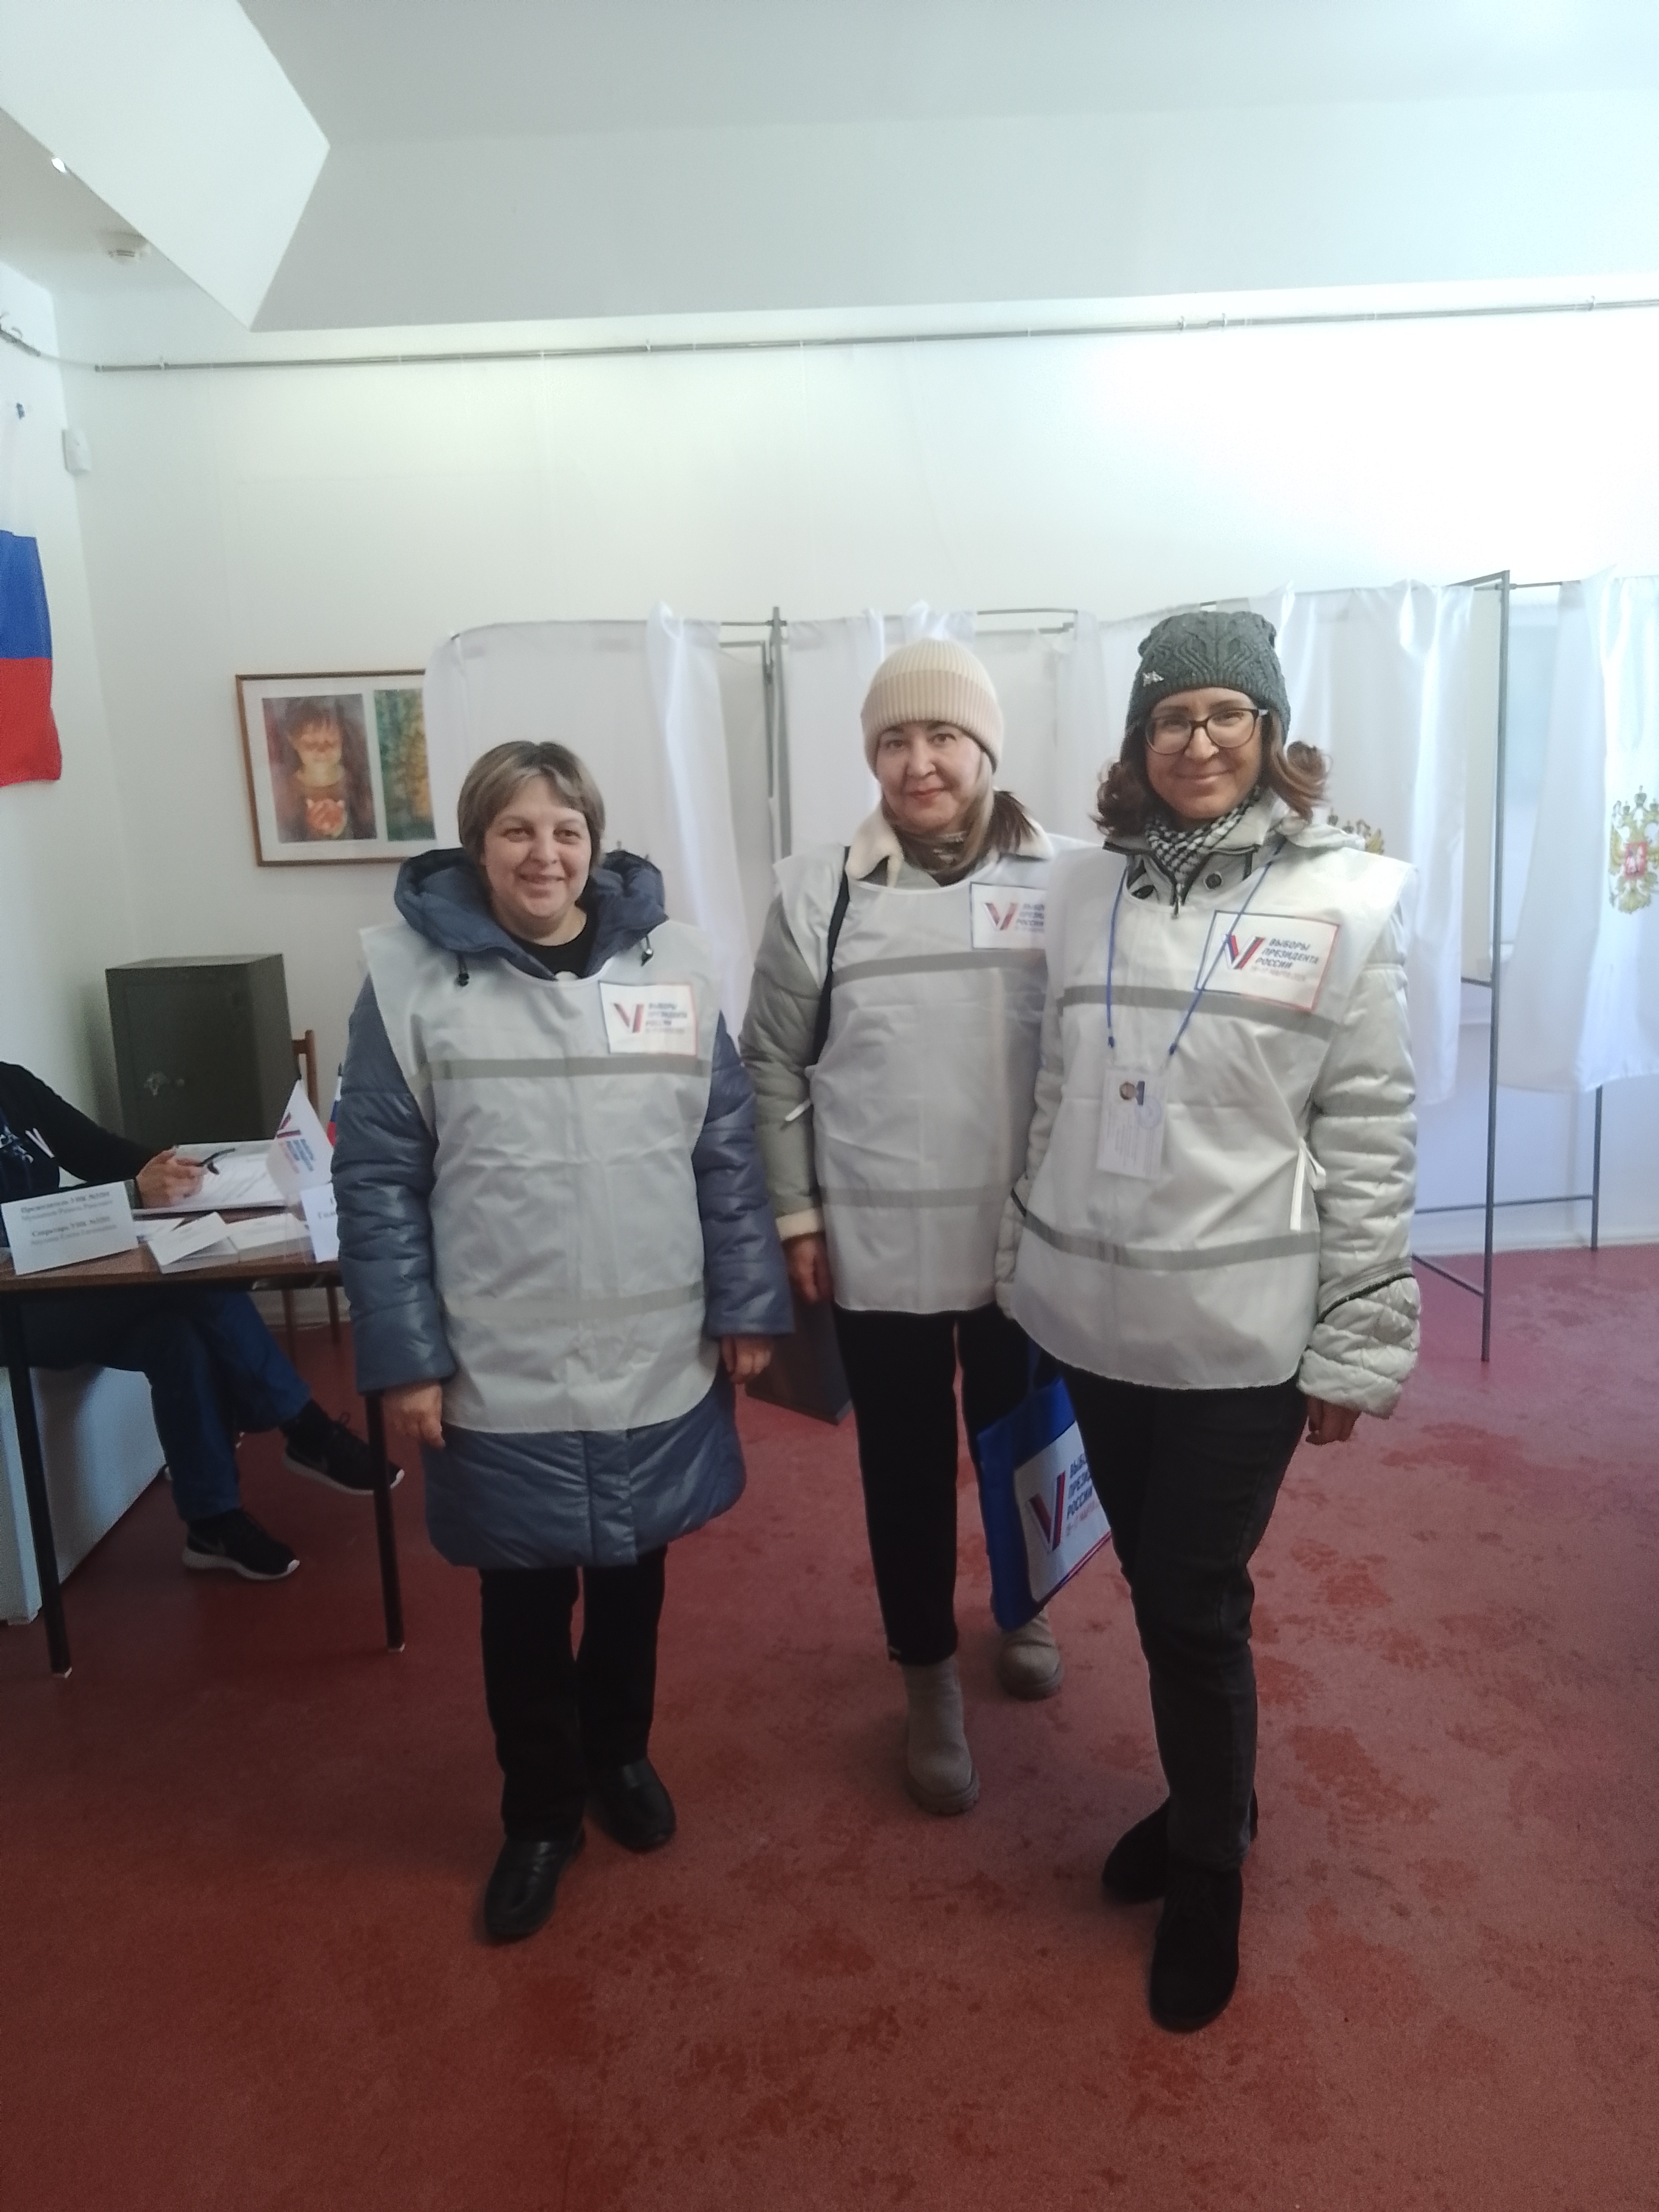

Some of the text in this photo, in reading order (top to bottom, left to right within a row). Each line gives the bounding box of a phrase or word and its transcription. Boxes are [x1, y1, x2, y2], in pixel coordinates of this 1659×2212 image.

[1269, 938, 1311, 951] ВЫБОРЫ
[1255, 957, 1293, 969] РОССИИ
[1262, 948, 1319, 965] ПРЕЗИДЕНТА
